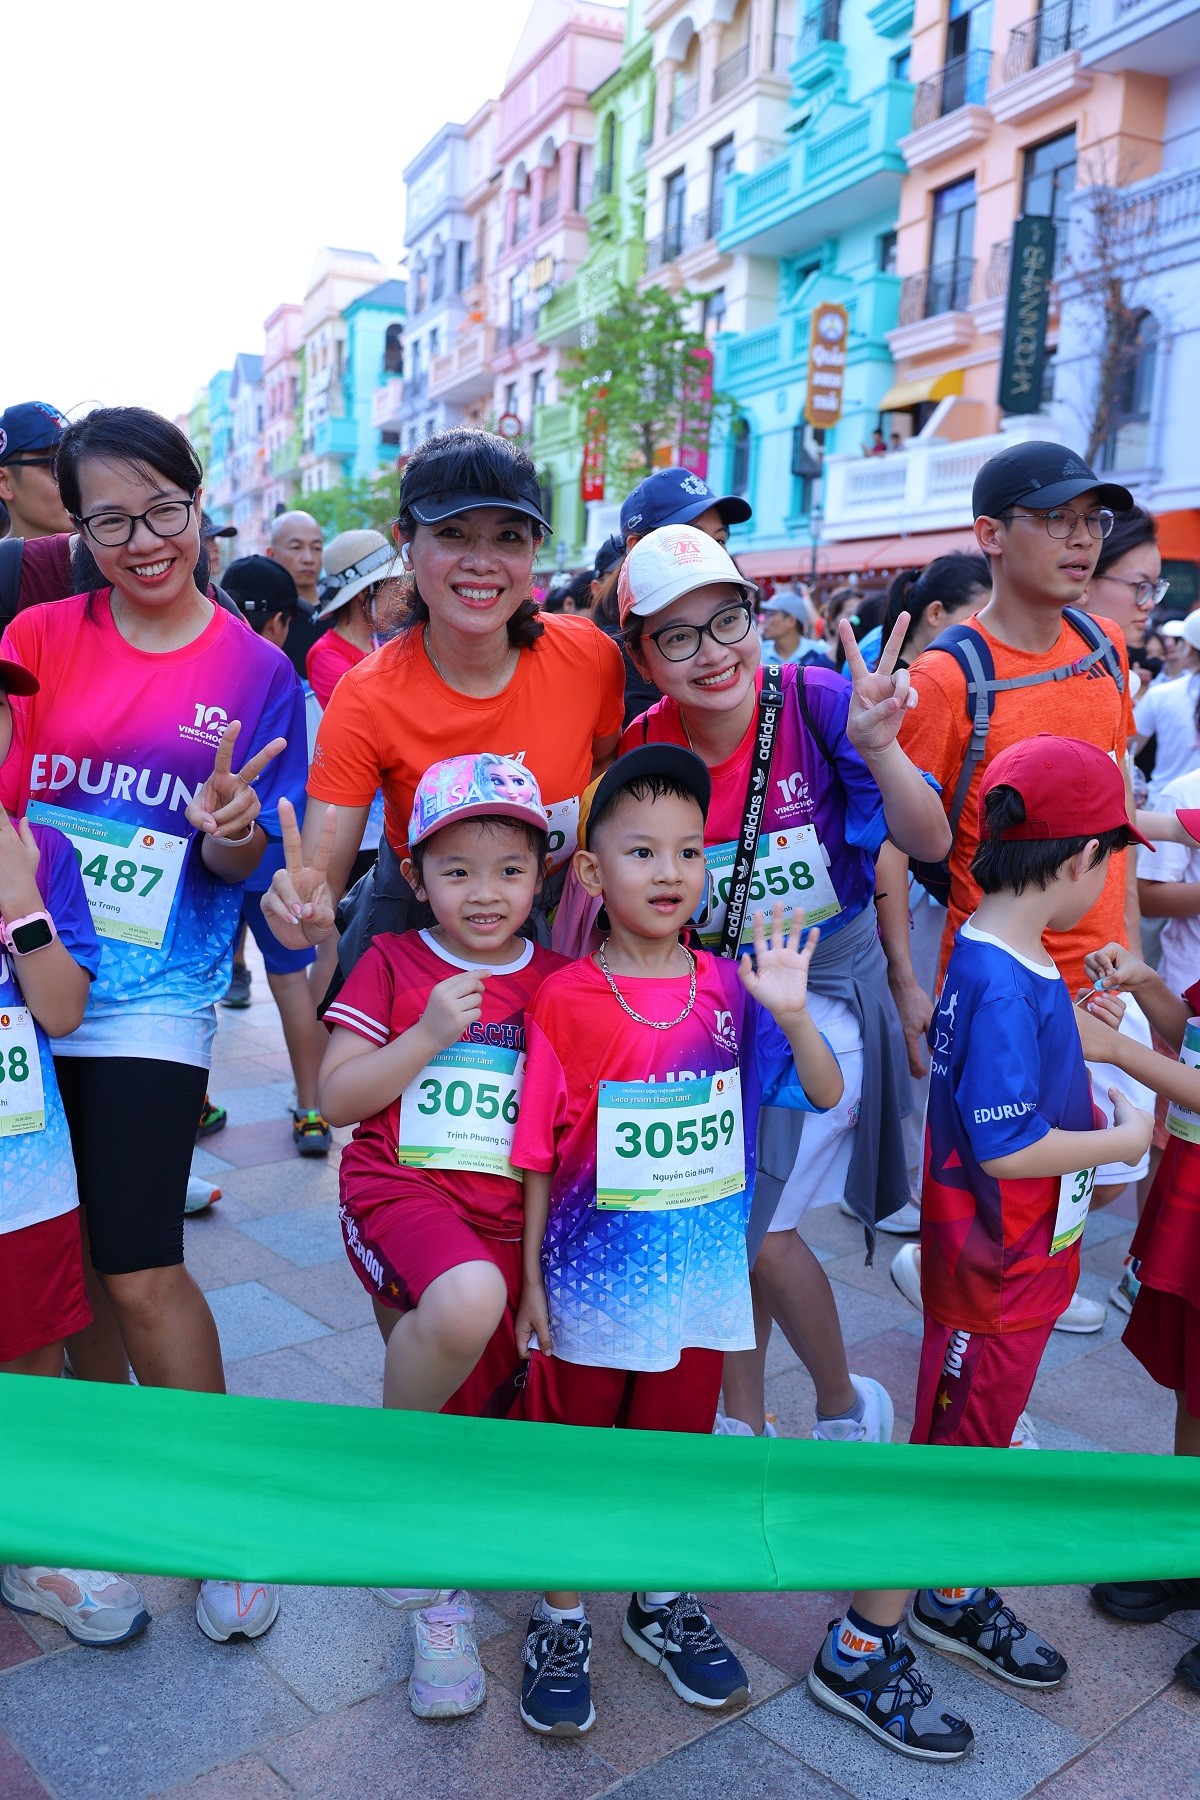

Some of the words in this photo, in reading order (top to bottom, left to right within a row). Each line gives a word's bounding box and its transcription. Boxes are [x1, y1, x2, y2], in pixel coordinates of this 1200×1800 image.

[178, 724, 222, 744] VINSCHO
[30, 754, 203, 811] EDURUN
[423, 781, 489, 821] ELSA
[743, 794, 762, 851] adidas
[74, 848, 164, 898] 487
[711, 860, 815, 910] 0558
[98, 901, 121, 914] Trang
[727, 883, 747, 938] adidas
[500, 1137, 511, 1147] Chi
[615, 1109, 735, 1159] 30559
[652, 1170, 684, 1182] Nguyễn
[684, 1169, 697, 1178] Gia
[841, 1629, 878, 1653] ONE
